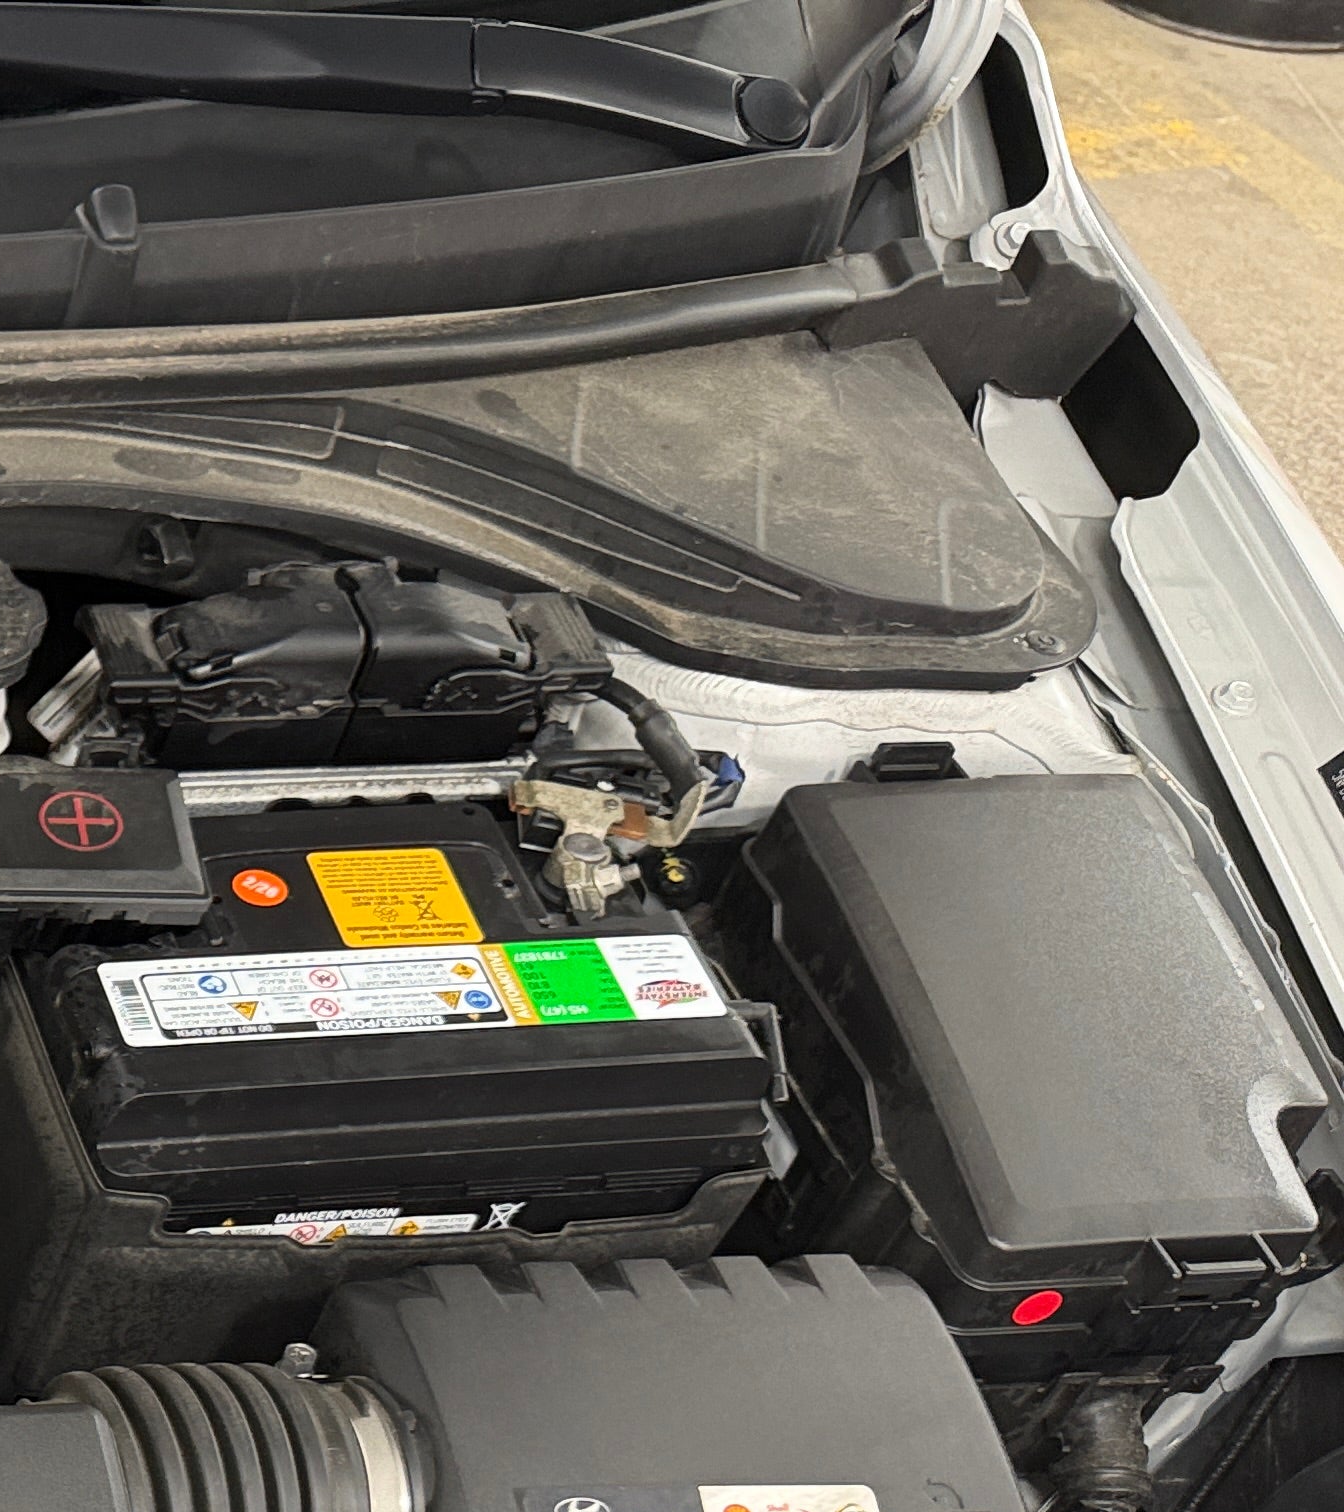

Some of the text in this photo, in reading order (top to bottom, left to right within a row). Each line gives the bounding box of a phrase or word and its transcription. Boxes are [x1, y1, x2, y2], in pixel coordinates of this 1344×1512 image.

[485, 950, 533, 1020] AUTOMOTIVE
[315, 1015, 447, 1031] DANGER/POISON
[274, 1207, 401, 1224] DANGER/POISON
[766, 1502, 790, 1512] Shell
